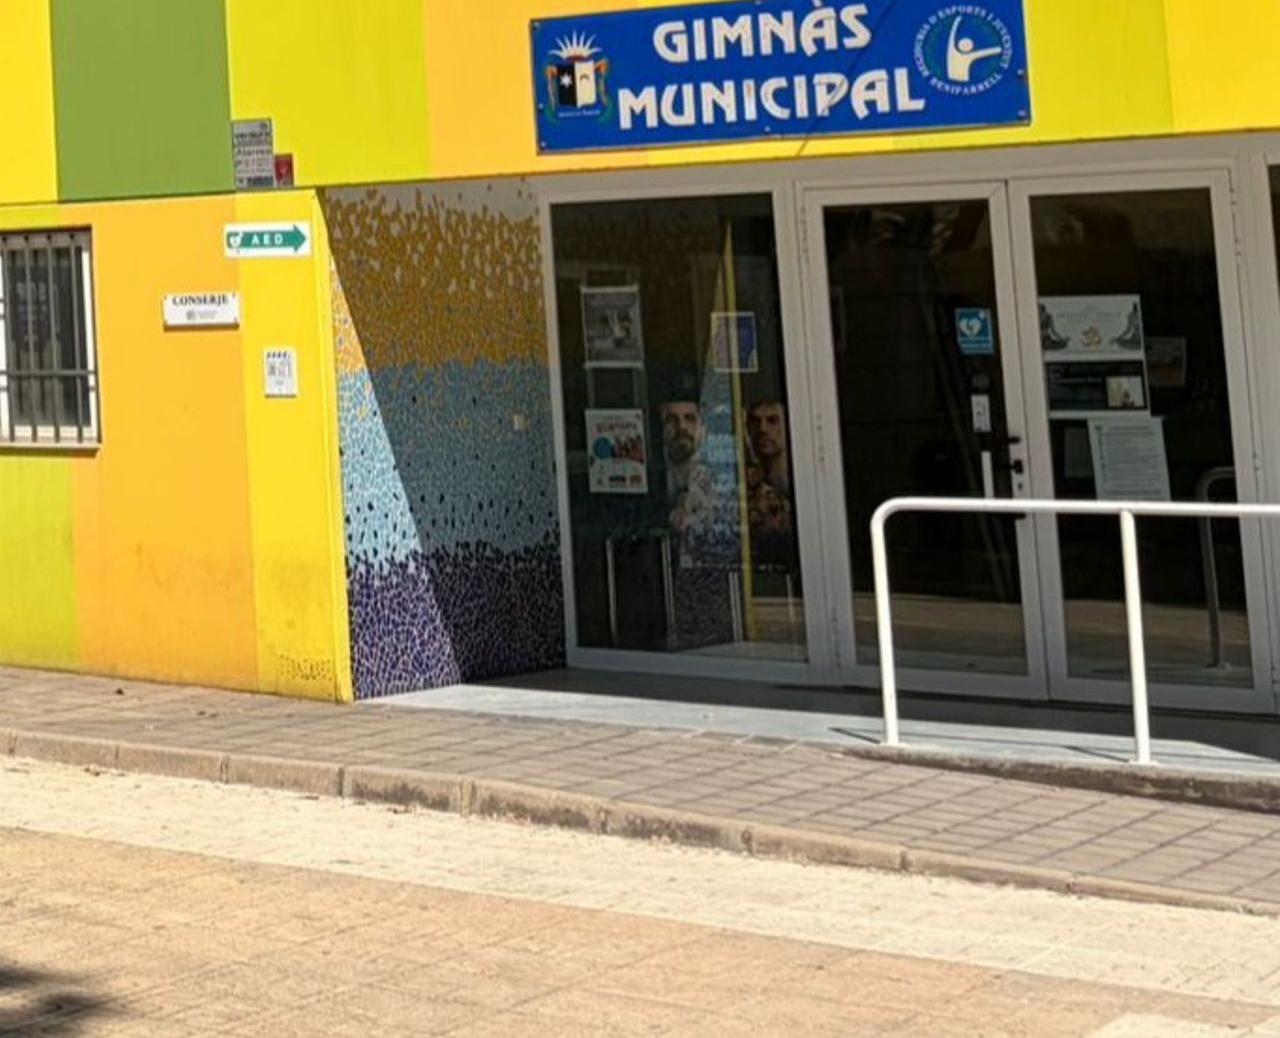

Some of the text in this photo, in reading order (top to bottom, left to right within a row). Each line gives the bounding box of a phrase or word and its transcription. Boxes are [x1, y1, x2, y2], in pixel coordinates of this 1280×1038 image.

[617, 66, 926, 131] MUNICIPAL
[251, 233, 284, 246] AED
[172, 295, 229, 306] CONSERJE
